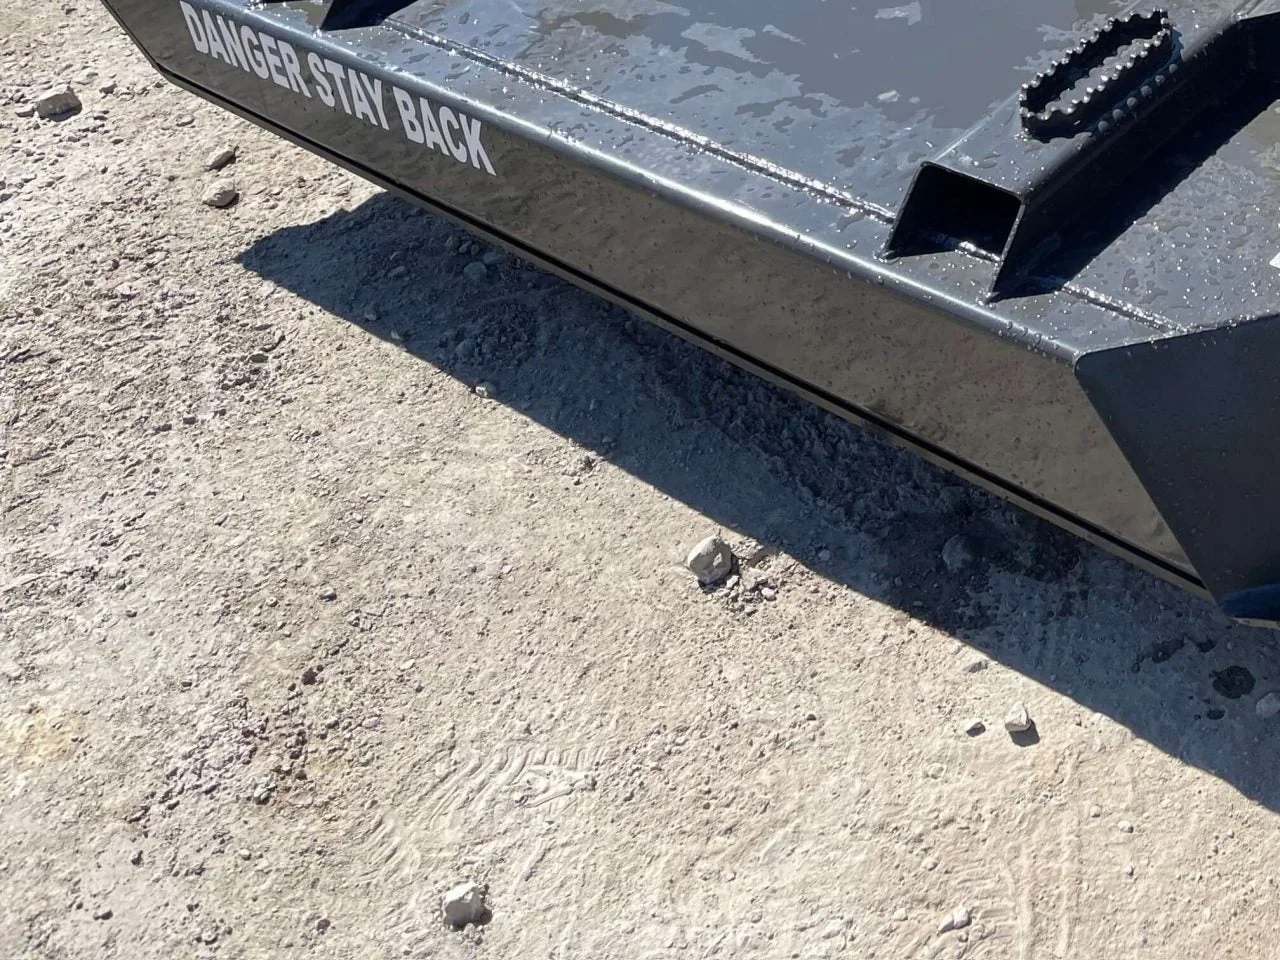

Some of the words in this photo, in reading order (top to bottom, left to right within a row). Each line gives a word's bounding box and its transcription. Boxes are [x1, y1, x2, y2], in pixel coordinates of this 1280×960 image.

[180, 0, 312, 98] DANGER
[306, 51, 390, 131] STAY
[392, 86, 497, 176] BACK
